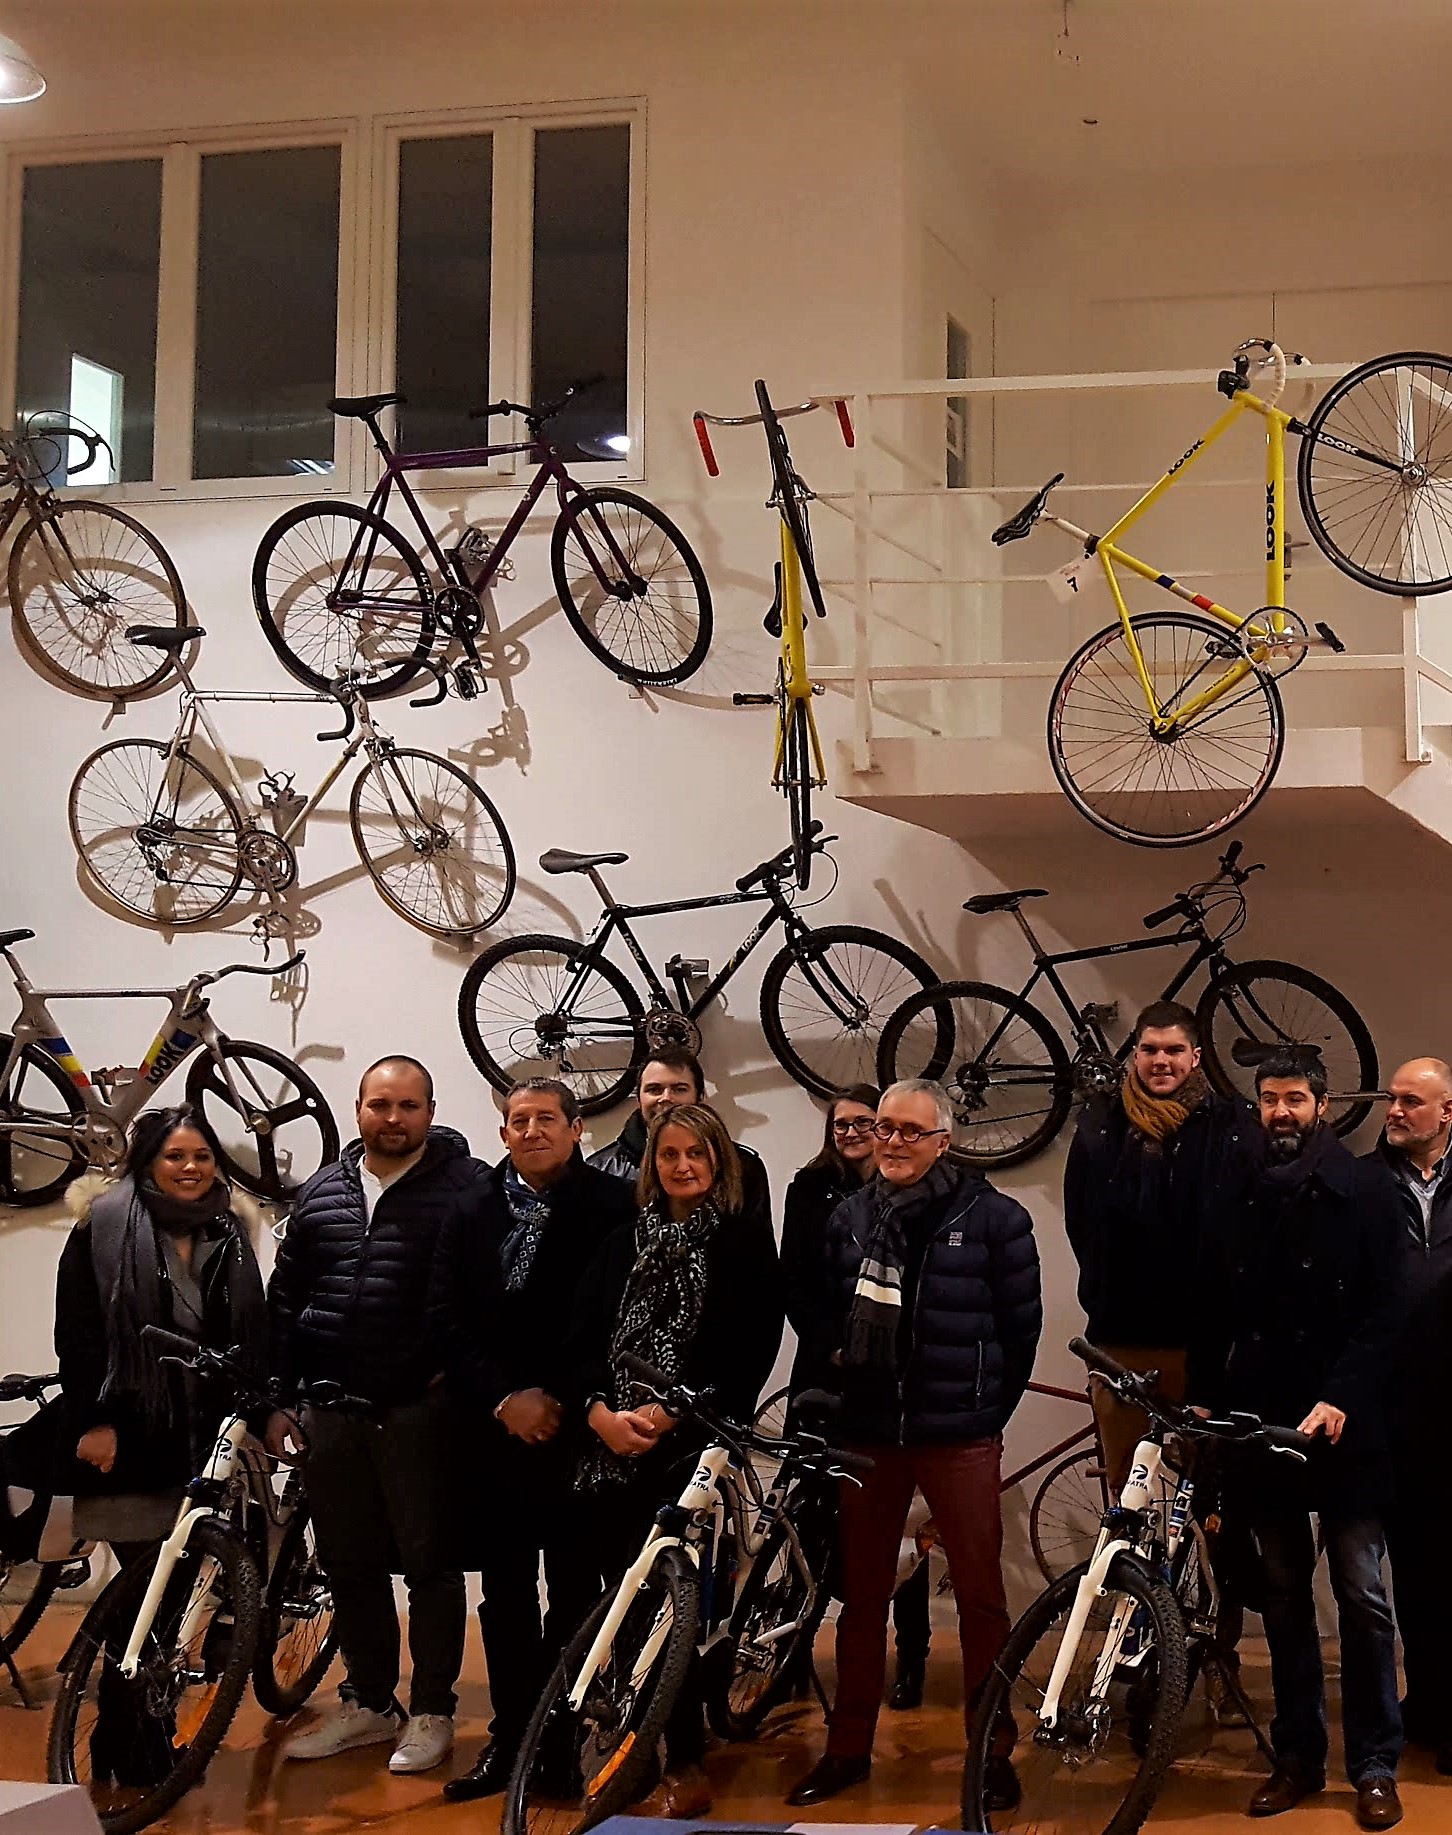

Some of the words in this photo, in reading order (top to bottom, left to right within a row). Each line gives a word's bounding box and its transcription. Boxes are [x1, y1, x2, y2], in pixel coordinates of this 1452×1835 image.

[1167, 438, 1206, 476] LOOK
[1317, 432, 1359, 456] LOOK
[1266, 480, 1275, 561] LOOK
[1066, 575, 1078, 593] 7
[742, 923, 764, 952] LOOK
[145, 1039, 185, 1086] LOOK
